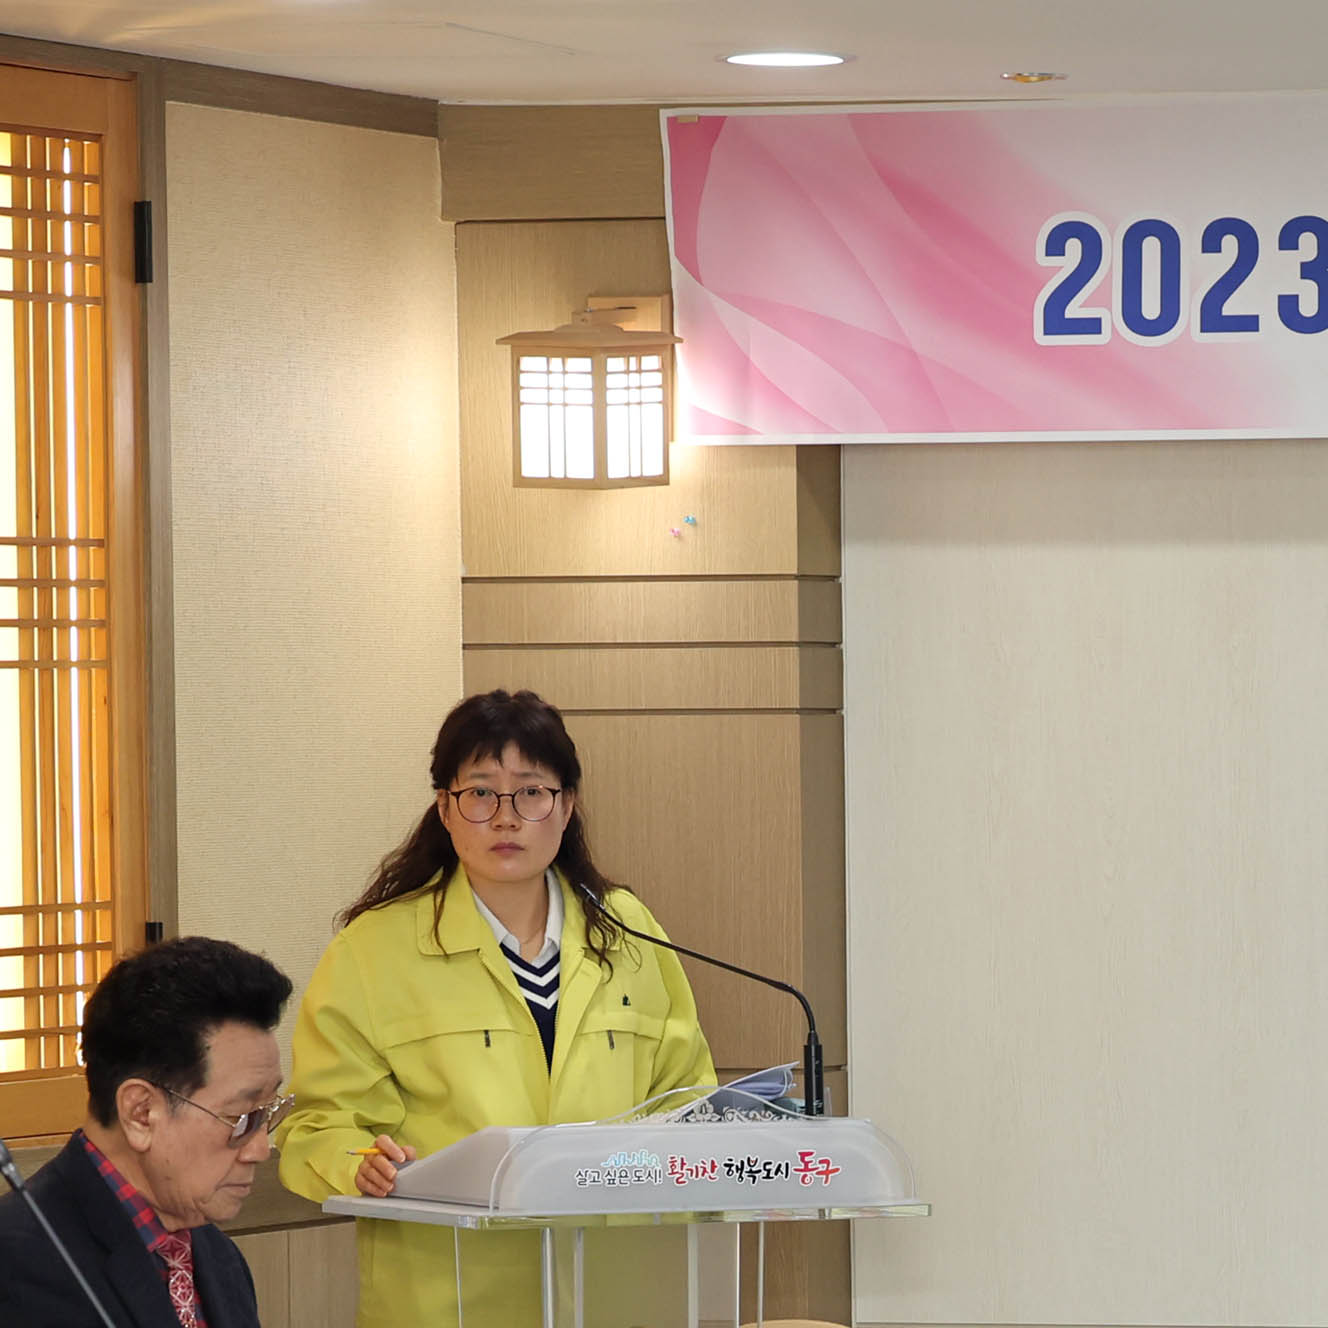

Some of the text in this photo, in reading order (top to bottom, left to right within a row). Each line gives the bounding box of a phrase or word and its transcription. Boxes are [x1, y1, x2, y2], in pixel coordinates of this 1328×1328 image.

[575, 1168, 662, 1187] 살고 싶은 도시!
[667, 1151, 841, 1186] 활기찬 행복도시 동구
